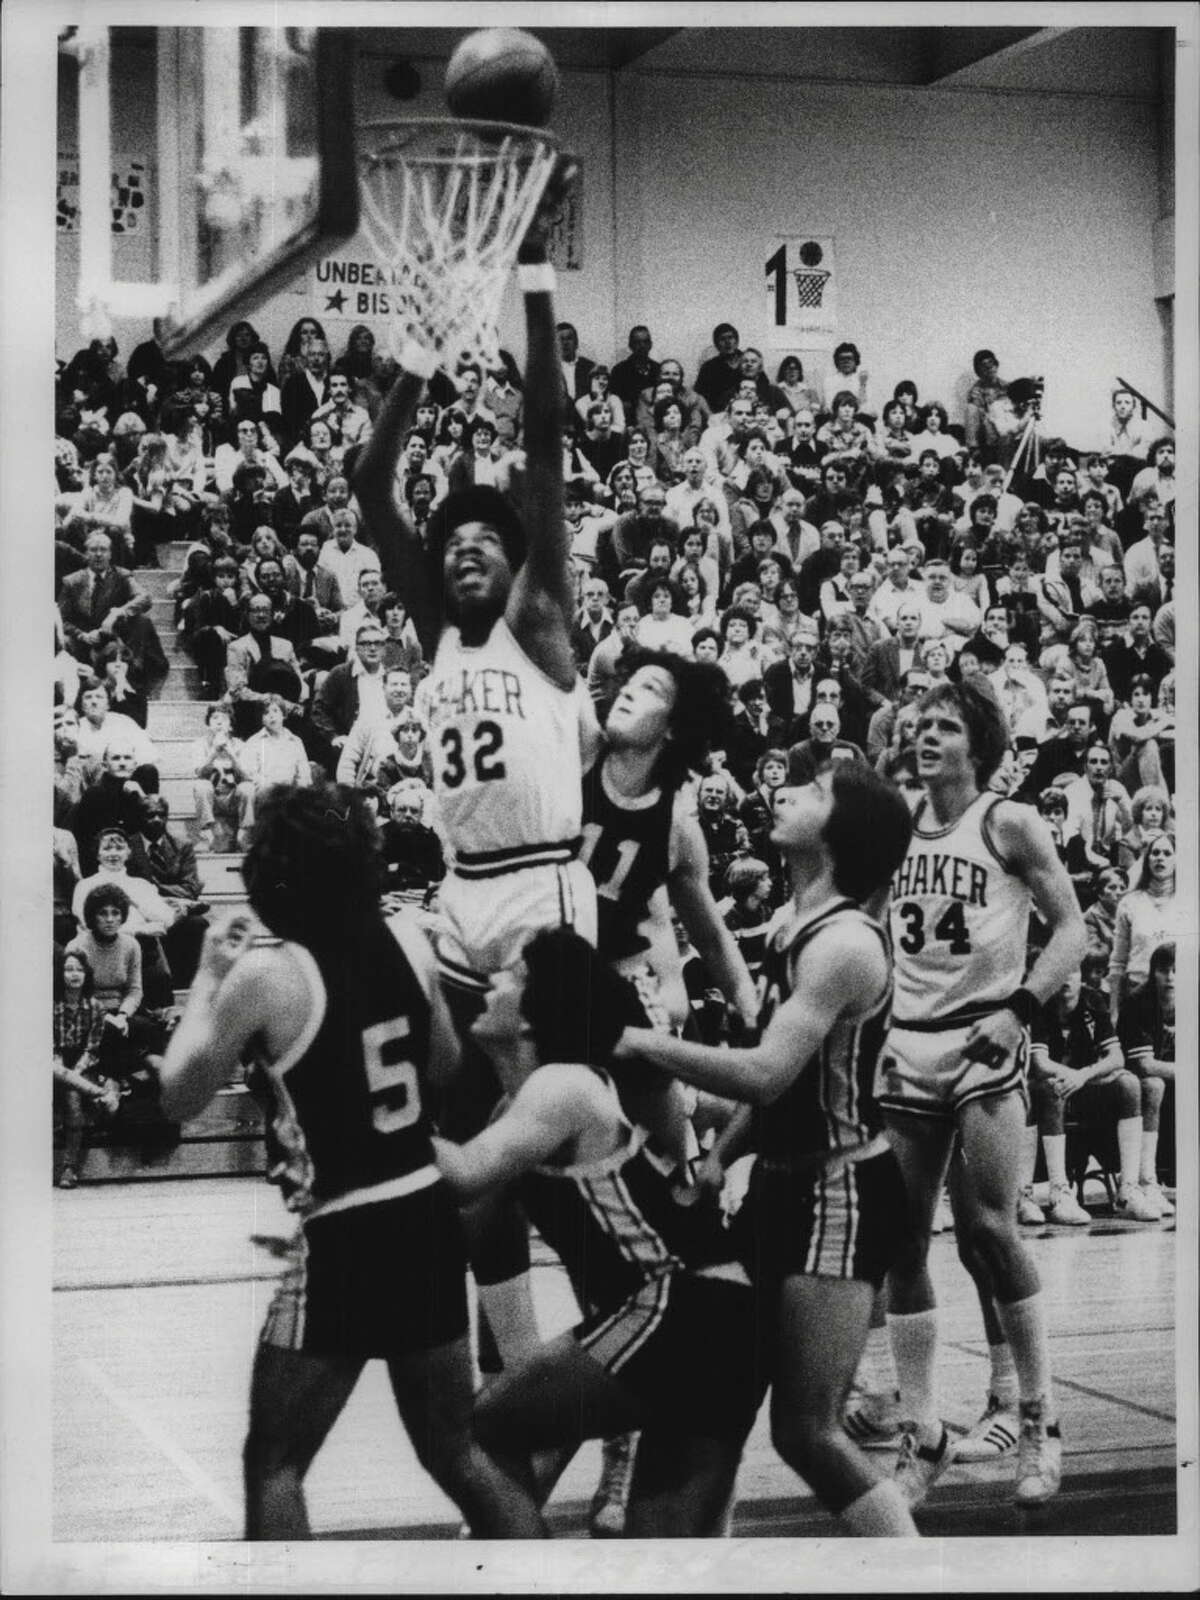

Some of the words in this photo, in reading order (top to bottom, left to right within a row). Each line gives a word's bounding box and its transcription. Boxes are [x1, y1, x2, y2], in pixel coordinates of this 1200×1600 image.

[440, 719, 507, 789] 32
[900, 901, 971, 956] 34
[362, 1015, 421, 1134] 5
